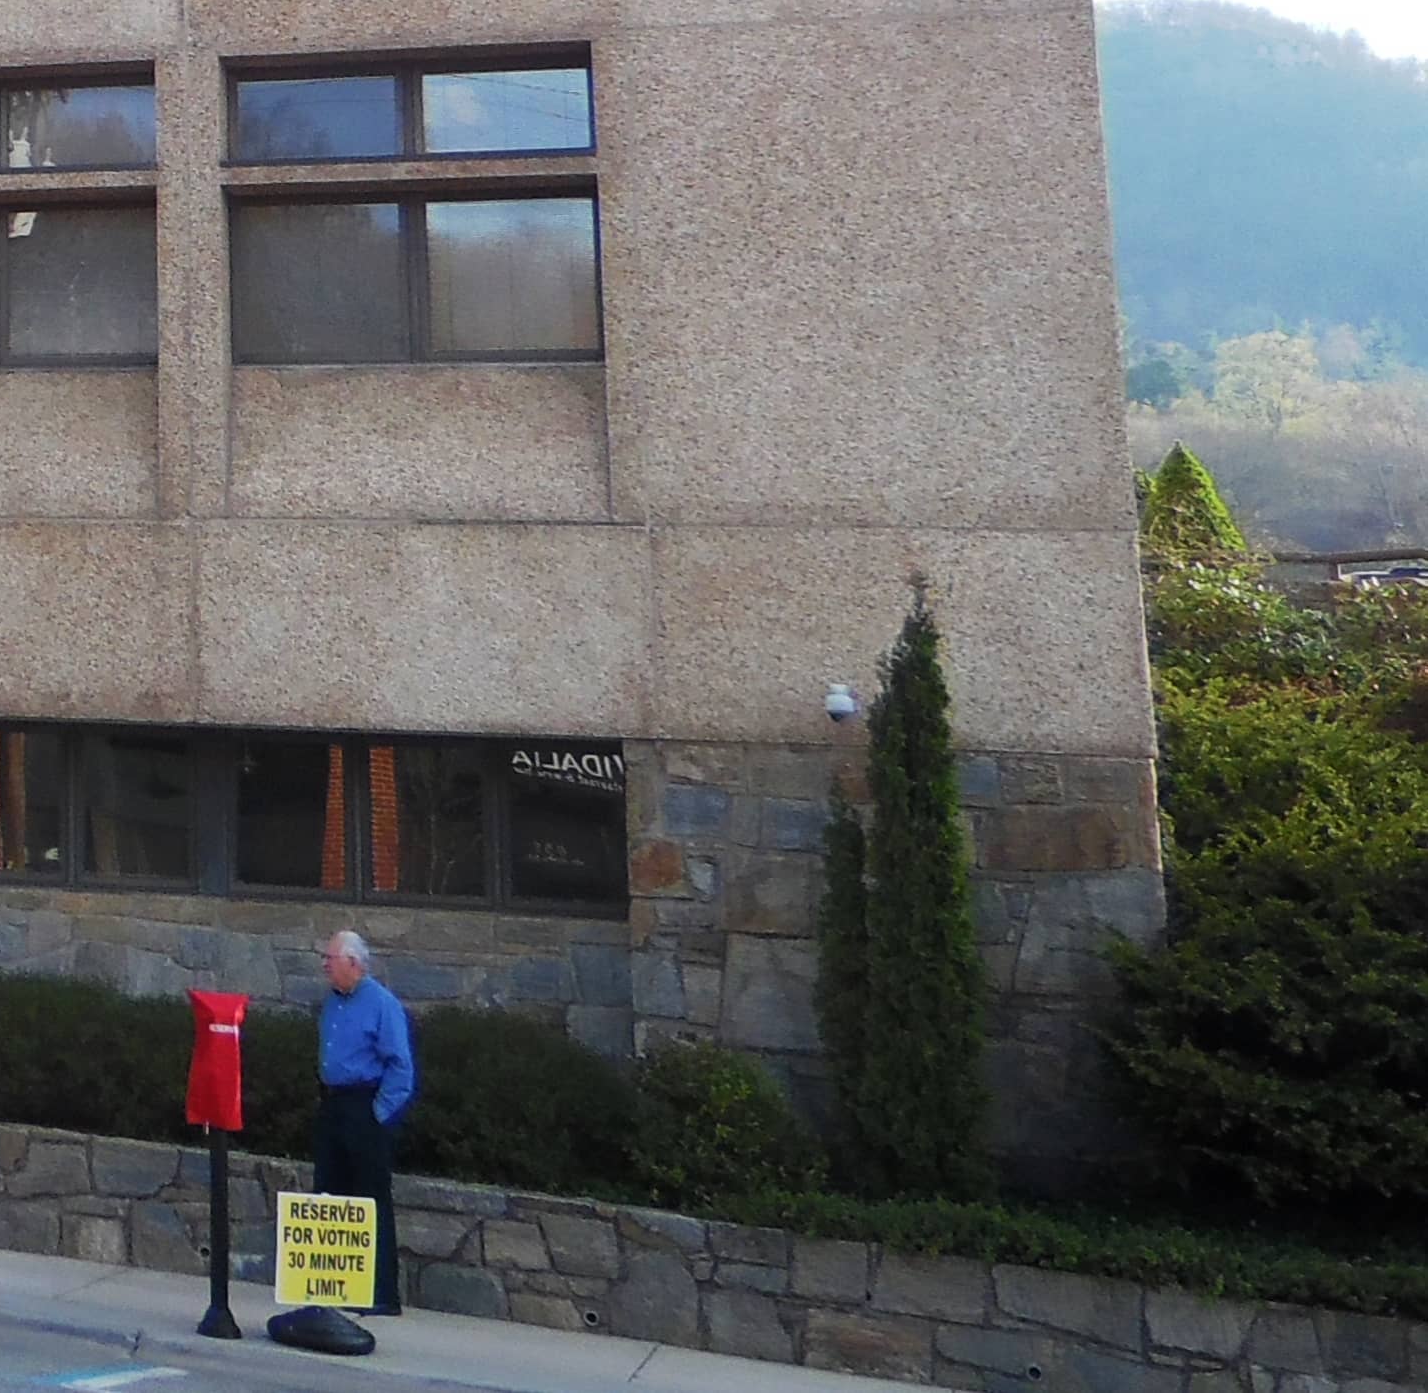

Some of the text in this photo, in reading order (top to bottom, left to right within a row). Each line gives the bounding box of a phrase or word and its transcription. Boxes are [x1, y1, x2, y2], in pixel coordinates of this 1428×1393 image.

[289, 1202, 366, 1223] RESERVED
[283, 1226, 370, 1248] FOR VOTING
[288, 1251, 365, 1272] 30 MINUTE
[306, 1278, 346, 1296] LIMIT
